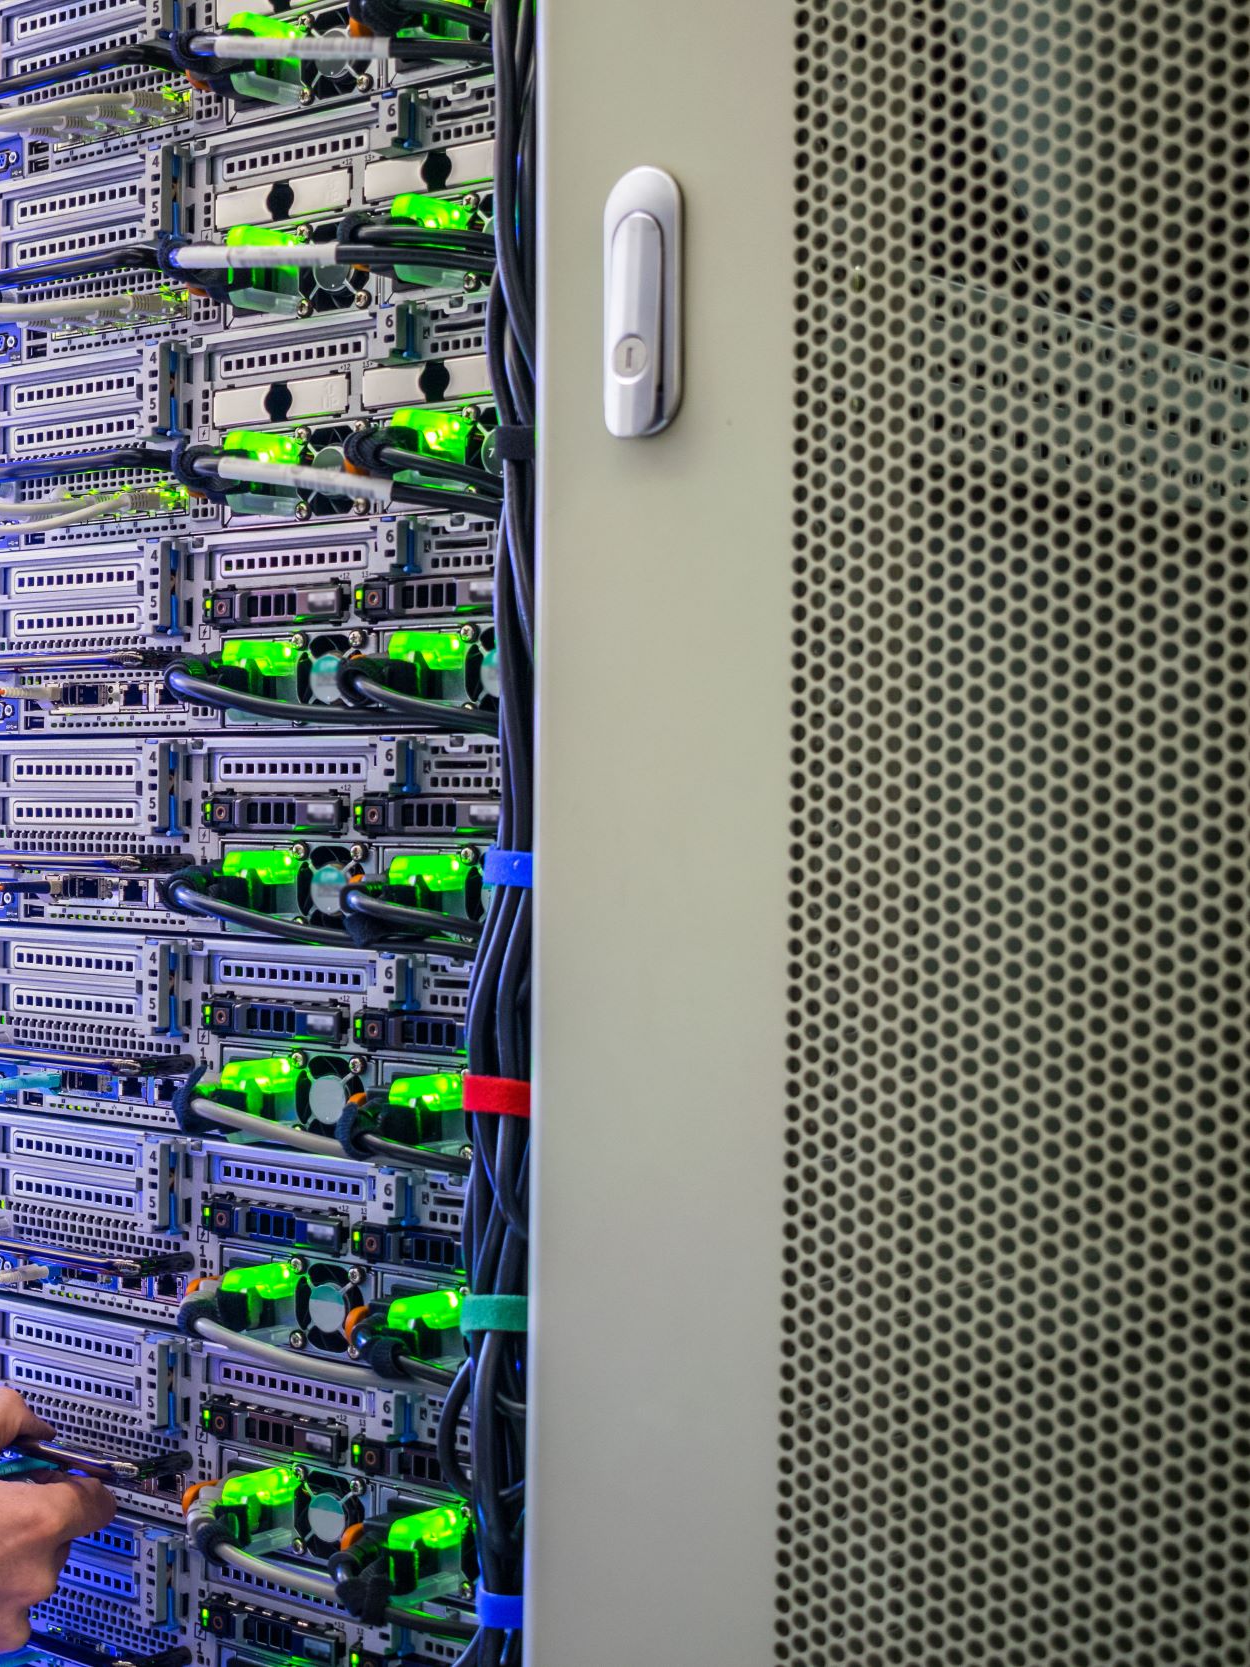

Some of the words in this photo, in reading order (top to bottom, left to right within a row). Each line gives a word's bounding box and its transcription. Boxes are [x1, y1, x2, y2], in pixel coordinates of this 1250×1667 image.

[153, 1, 159, 13] 5
[388, 104, 395, 117] 6
[152, 156, 159, 167] 4
[152, 201, 158, 213] 5
[386, 315, 393, 328] 6
[150, 352, 157, 363] 4
[150, 398, 156, 410] 5
[386, 530, 394, 543] 6
[151, 550, 158, 561] 4
[151, 596, 157, 608] 5
[149, 752, 156, 763] 4
[386, 749, 393, 761] 6
[150, 797, 156, 809] 5
[150, 952, 156, 963] 4
[385, 966, 393, 979] 6
[150, 998, 156, 1009] 5
[150, 1151, 157, 1162] 4
[384, 1184, 392, 1196] 6
[150, 1196, 156, 1208] 5
[148, 1351, 155, 1362] 4
[148, 1396, 154, 1408] 5
[383, 1401, 391, 1414] 6
[147, 1548, 153, 1559] 4
[147, 1592, 153, 1604] 5
